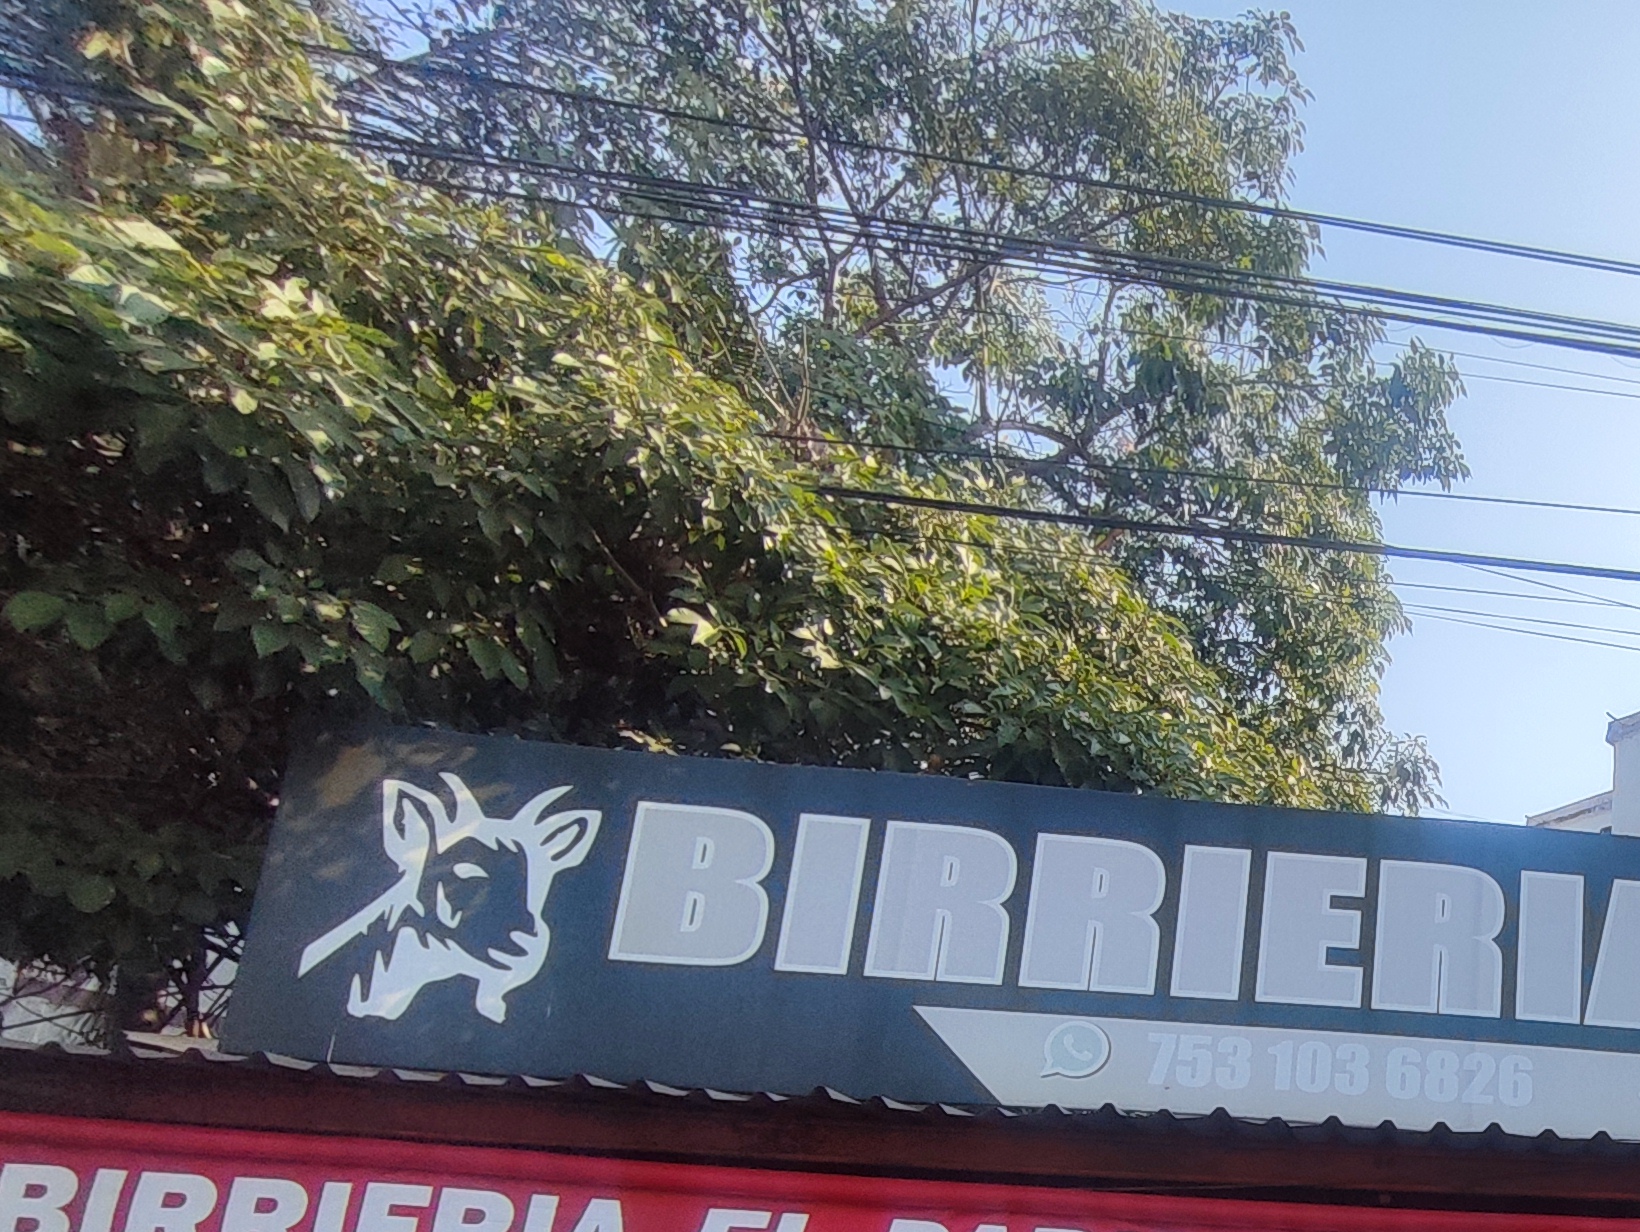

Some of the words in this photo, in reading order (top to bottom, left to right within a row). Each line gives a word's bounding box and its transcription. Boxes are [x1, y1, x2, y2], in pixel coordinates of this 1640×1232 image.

[1147, 1030, 1252, 1092] 753
[1266, 1038, 1370, 1096] 103
[1386, 1046, 1535, 1108] 6826
